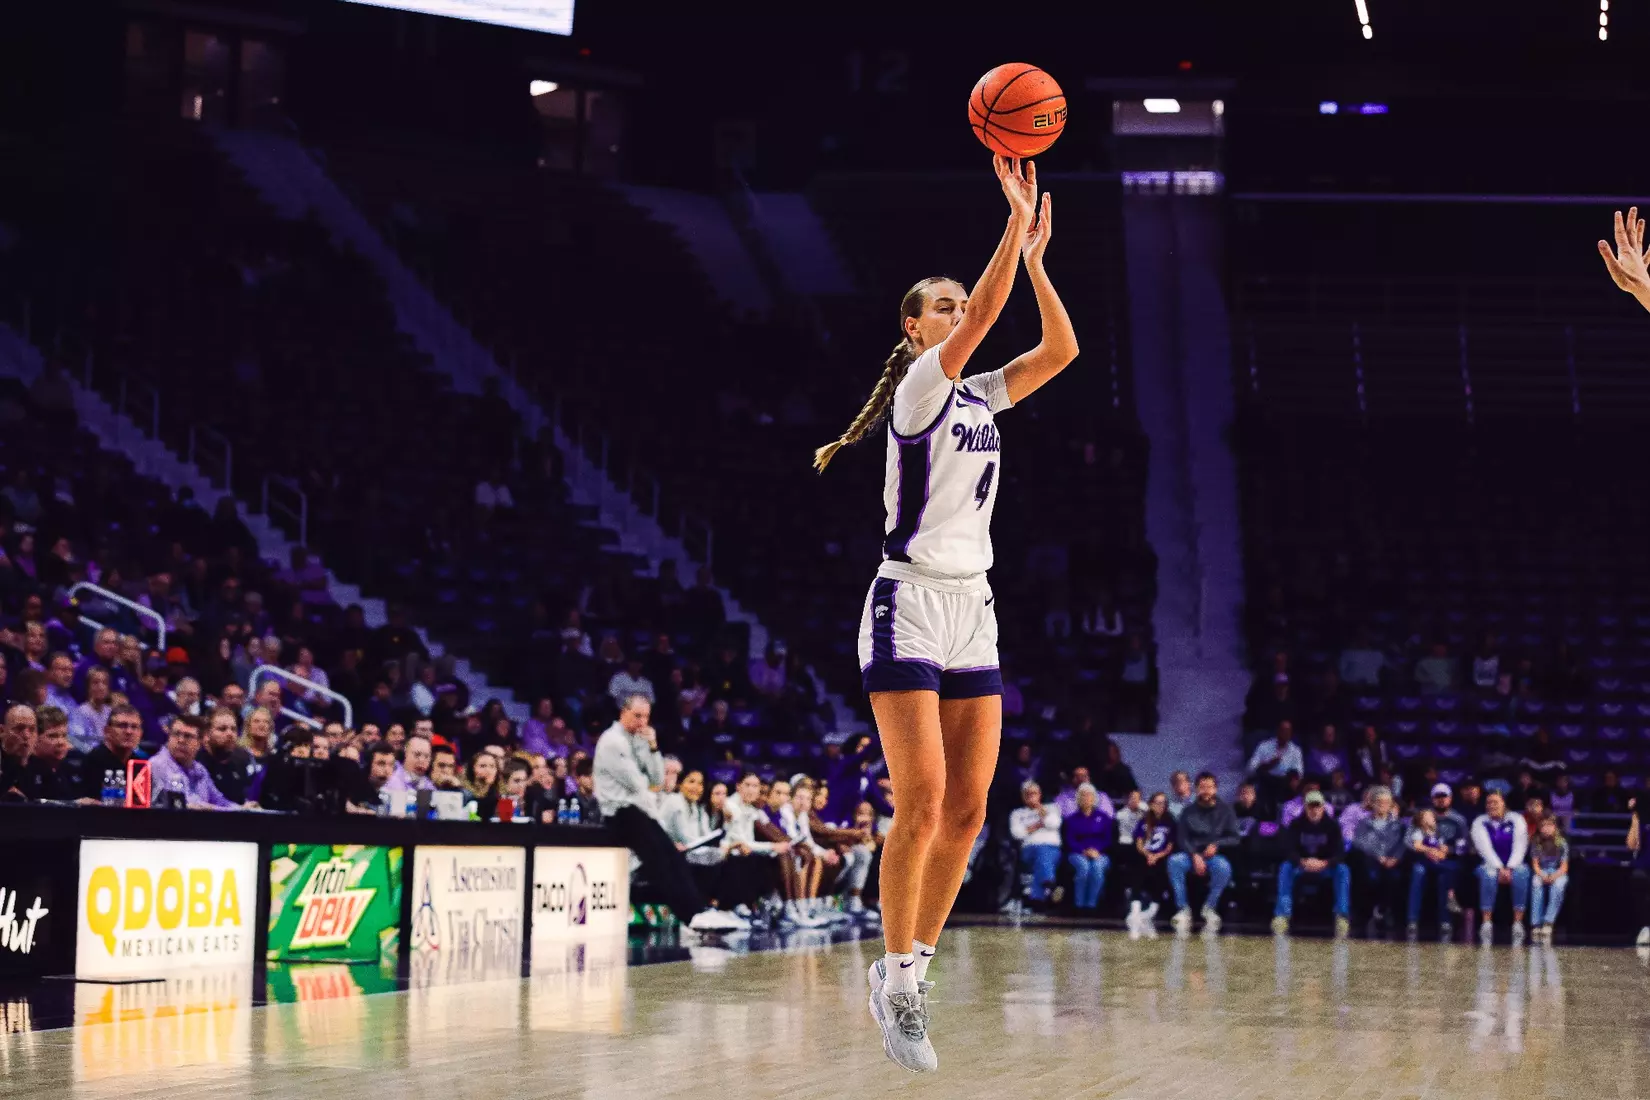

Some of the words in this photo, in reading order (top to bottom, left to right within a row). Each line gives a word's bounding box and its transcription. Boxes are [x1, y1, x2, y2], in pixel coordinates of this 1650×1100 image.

[974, 461, 996, 511] 4
[448, 856, 516, 893] Ascension
[86, 865, 242, 957] QDOBA
[533, 883, 566, 913] TACO
[591, 882, 617, 911] BELL
[122, 937, 195, 957] MEXICAN
[203, 934, 240, 953] EATS
